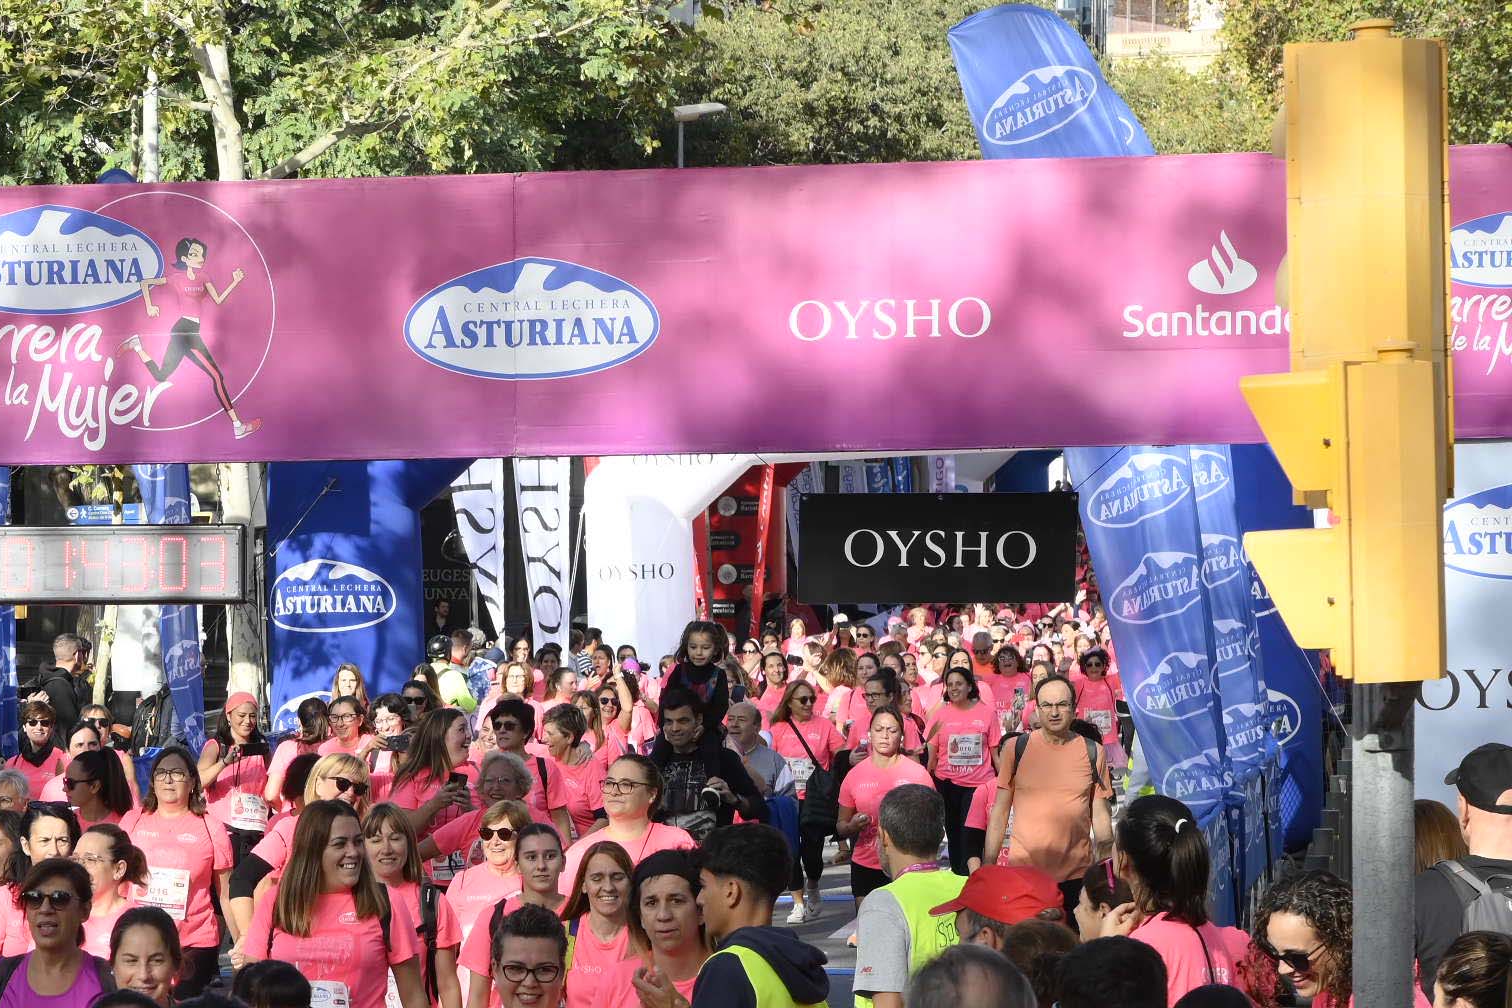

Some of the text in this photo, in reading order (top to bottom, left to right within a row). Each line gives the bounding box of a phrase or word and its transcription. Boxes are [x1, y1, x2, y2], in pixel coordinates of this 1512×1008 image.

[67, 240, 140, 253] LECHERA
[463, 298, 631, 314] CENTRAL LECHERA
[789, 296, 991, 342] OYSHO
[425, 305, 640, 350] ASTURIANA
[5, 364, 29, 406] la
[24, 356, 174, 451] Mujer
[843, 528, 1037, 570] OYSHO
[274, 588, 387, 617] ASTURIANA
[286, 582, 382, 594] CENTRAL LECHERA
